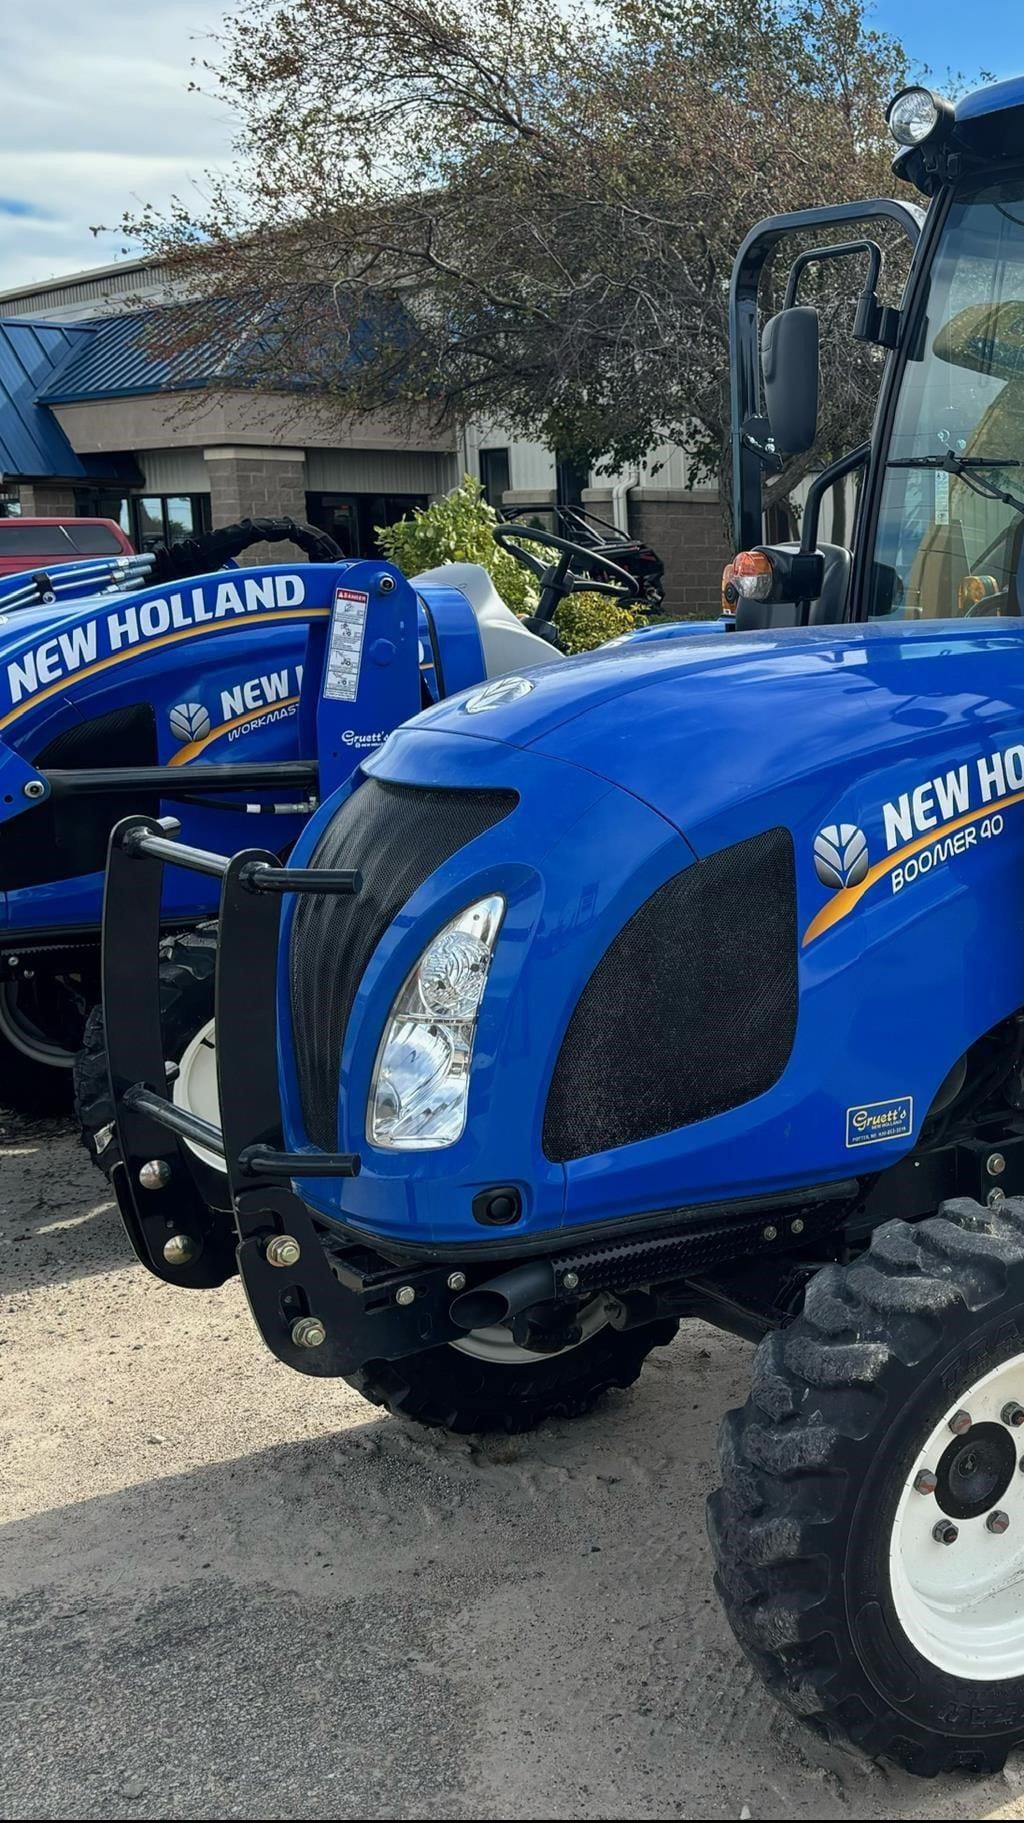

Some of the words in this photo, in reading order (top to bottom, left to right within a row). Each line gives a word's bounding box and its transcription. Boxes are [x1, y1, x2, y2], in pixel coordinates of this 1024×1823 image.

[7, 620, 97, 704] NEW
[107, 574, 305, 650] HOLLAND
[220, 669, 289, 721] NEW
[882, 764, 970, 851] NEW
[891, 828, 977, 894] BOOMER
[980, 814, 1004, 840] 40
[852, 1106, 907, 1132] Gruett's
